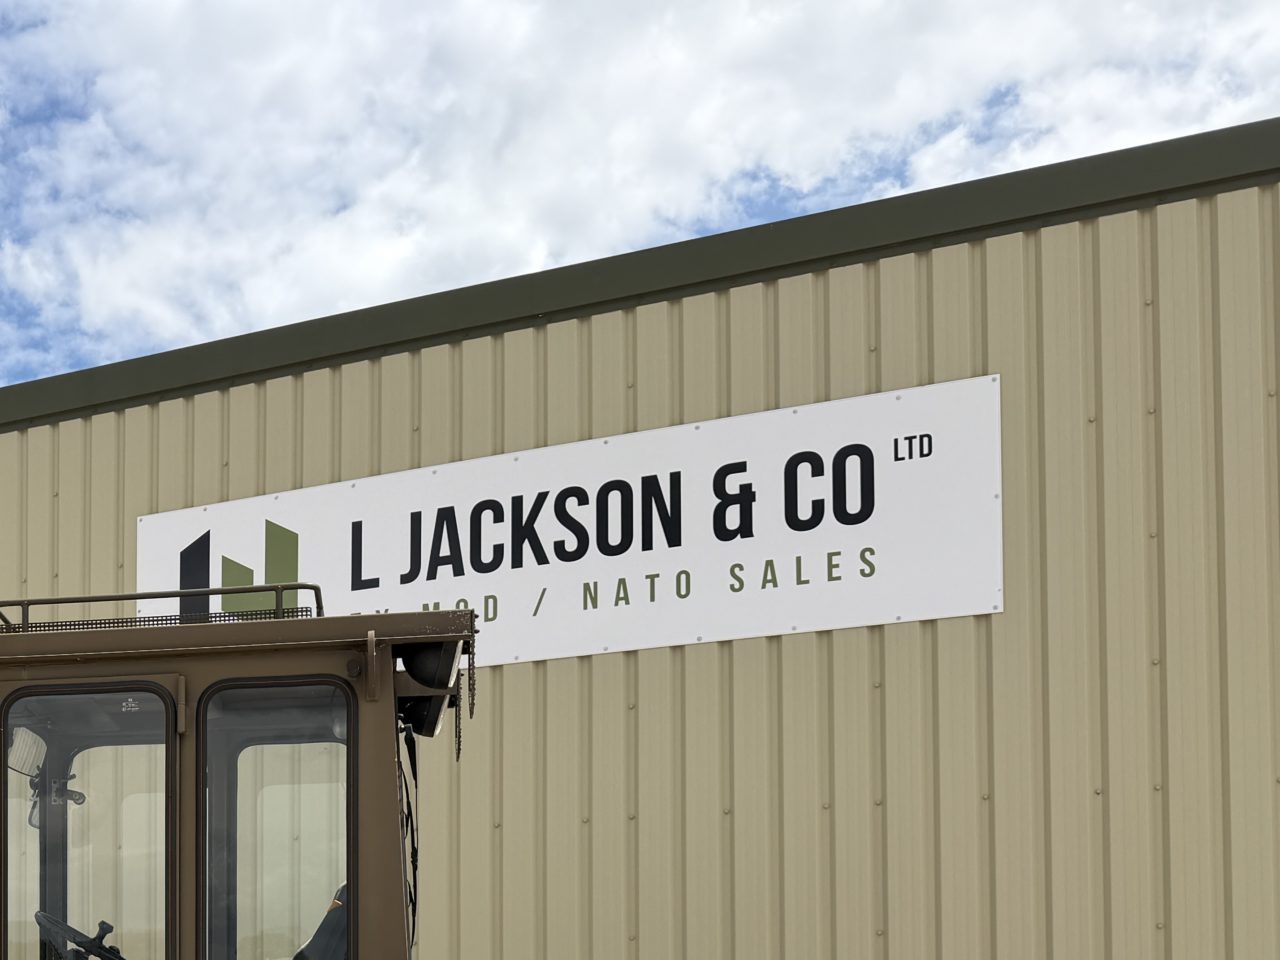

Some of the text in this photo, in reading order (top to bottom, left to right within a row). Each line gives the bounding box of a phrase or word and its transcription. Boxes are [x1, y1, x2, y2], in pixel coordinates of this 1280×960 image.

[351, 434, 932, 591] L JACKSON & CO LTD
[583, 570, 690, 610] NATO
[730, 548, 875, 592] SALES
